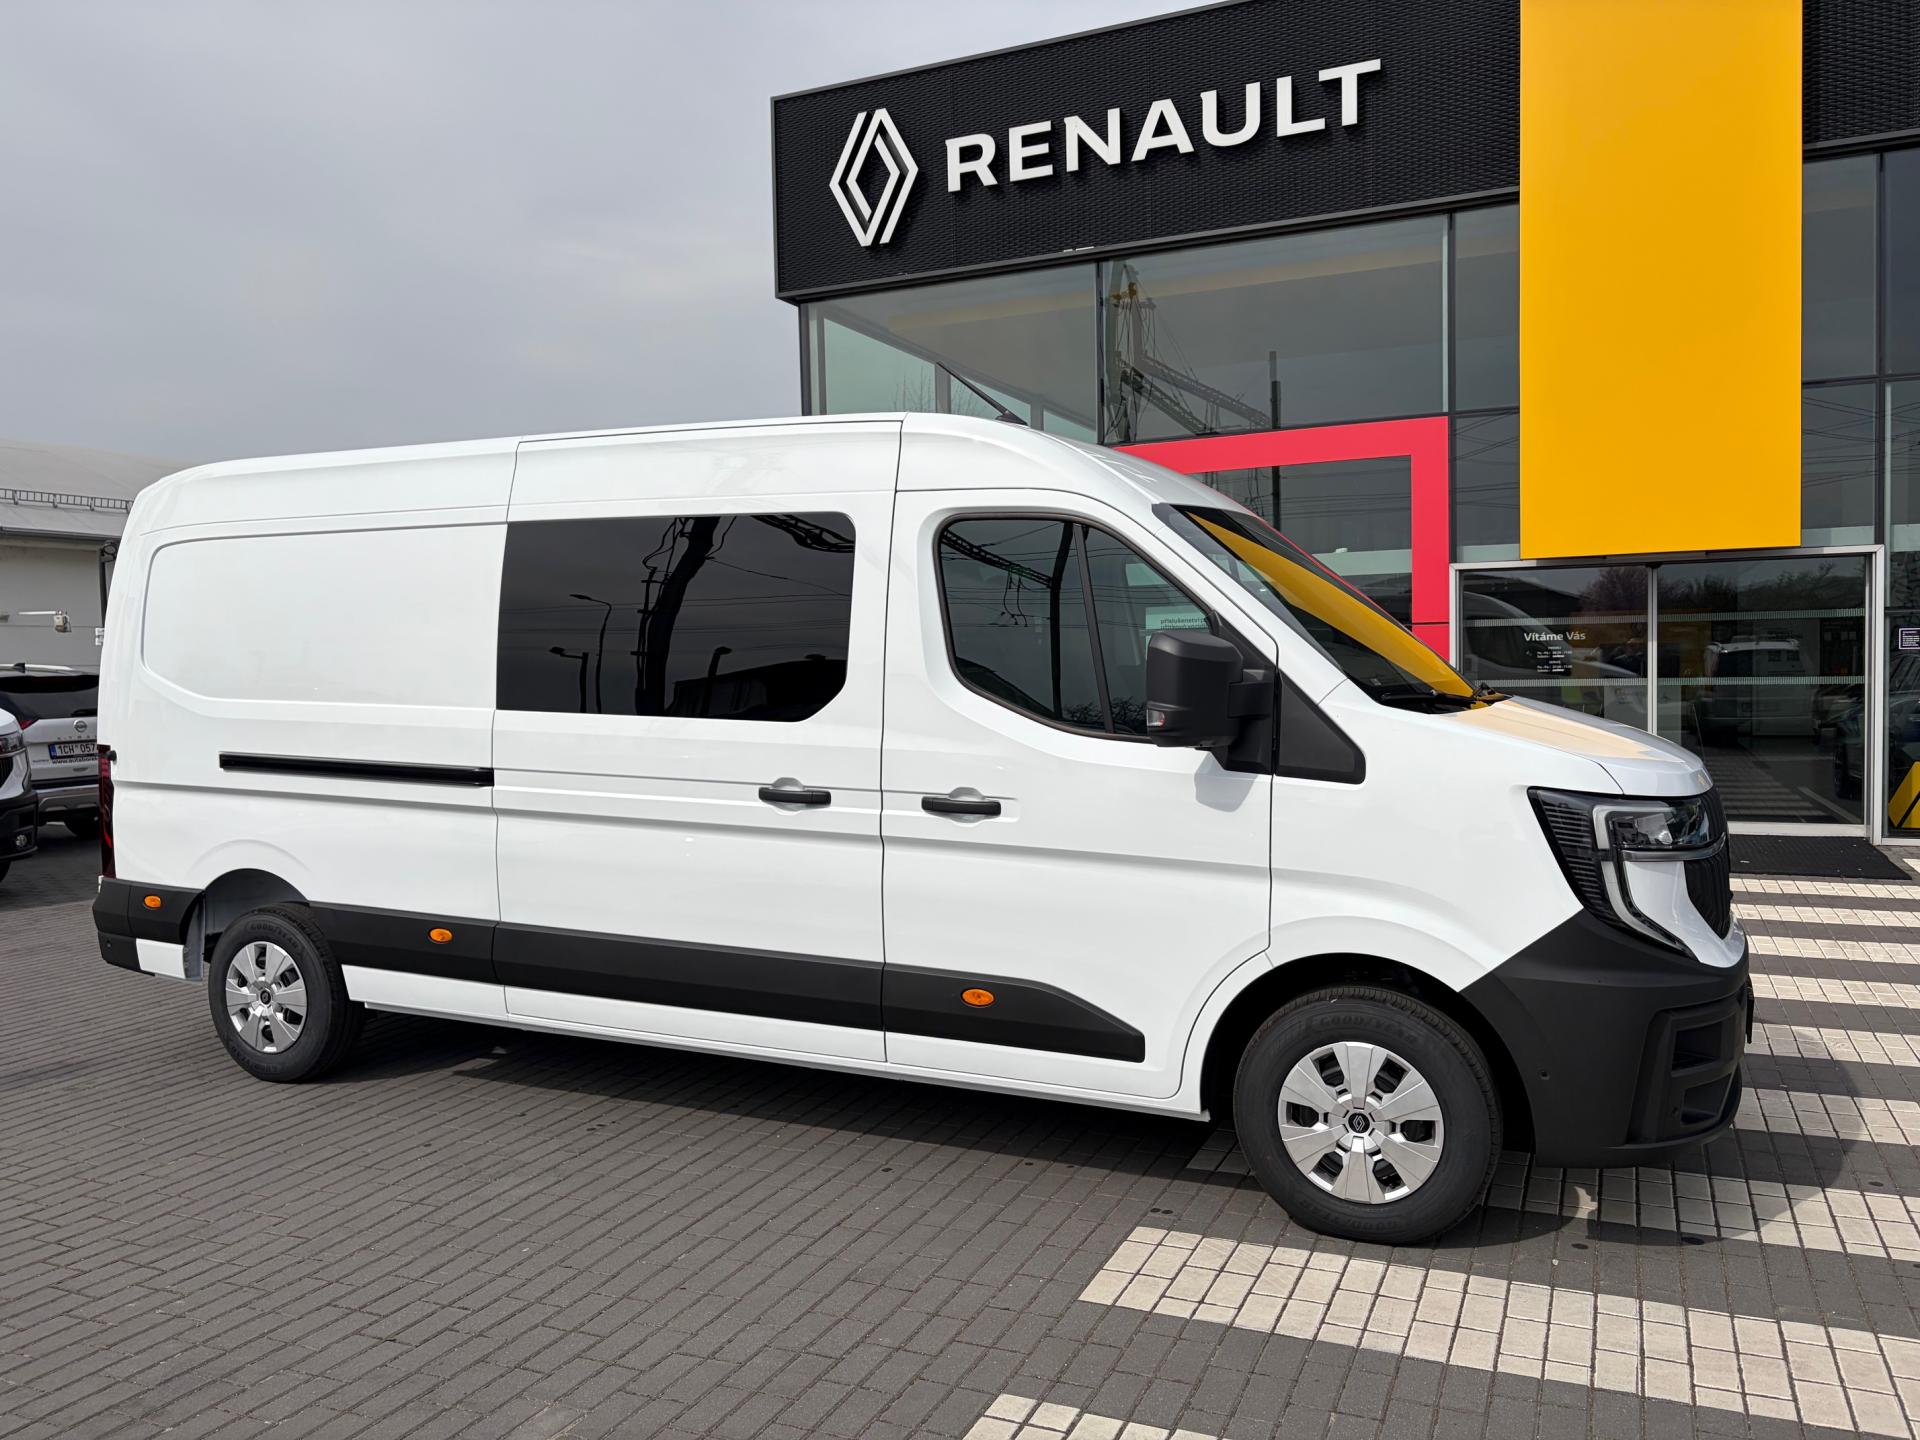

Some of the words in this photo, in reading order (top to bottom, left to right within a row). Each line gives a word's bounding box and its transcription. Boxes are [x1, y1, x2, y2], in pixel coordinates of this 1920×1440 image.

[945, 58, 1382, 193] RENAULT
[1523, 631, 1564, 641] Vítáme
[1566, 631, 1586, 640] Vás
[58, 744, 75, 754] 1CH
